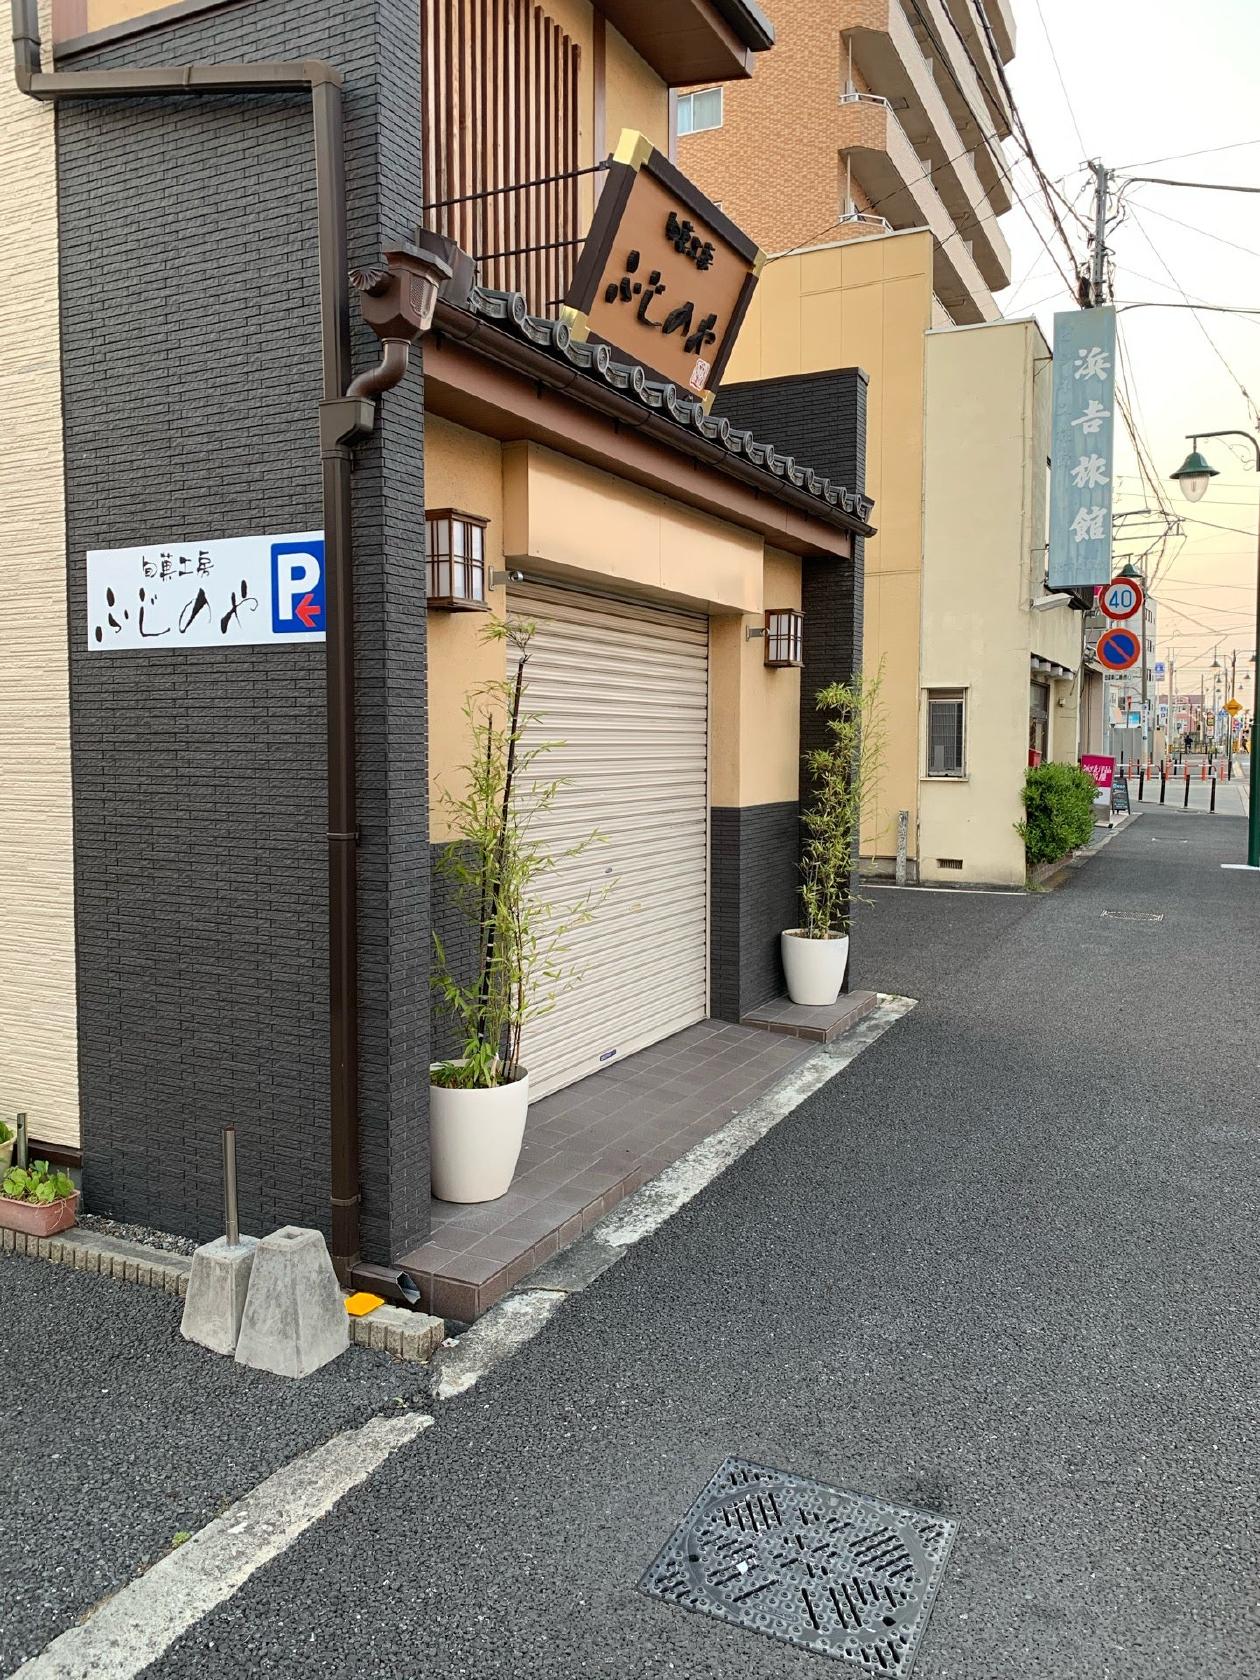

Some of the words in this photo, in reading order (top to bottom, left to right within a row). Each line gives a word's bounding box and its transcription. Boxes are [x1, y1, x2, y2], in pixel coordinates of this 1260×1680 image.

[604, 249, 717, 355] ふじのや
[1069, 347, 1112, 544] 浜吉旅館
[95, 579, 259, 643] ふじのや
[277, 552, 321, 621] P
[1108, 589, 1133, 609] 40
